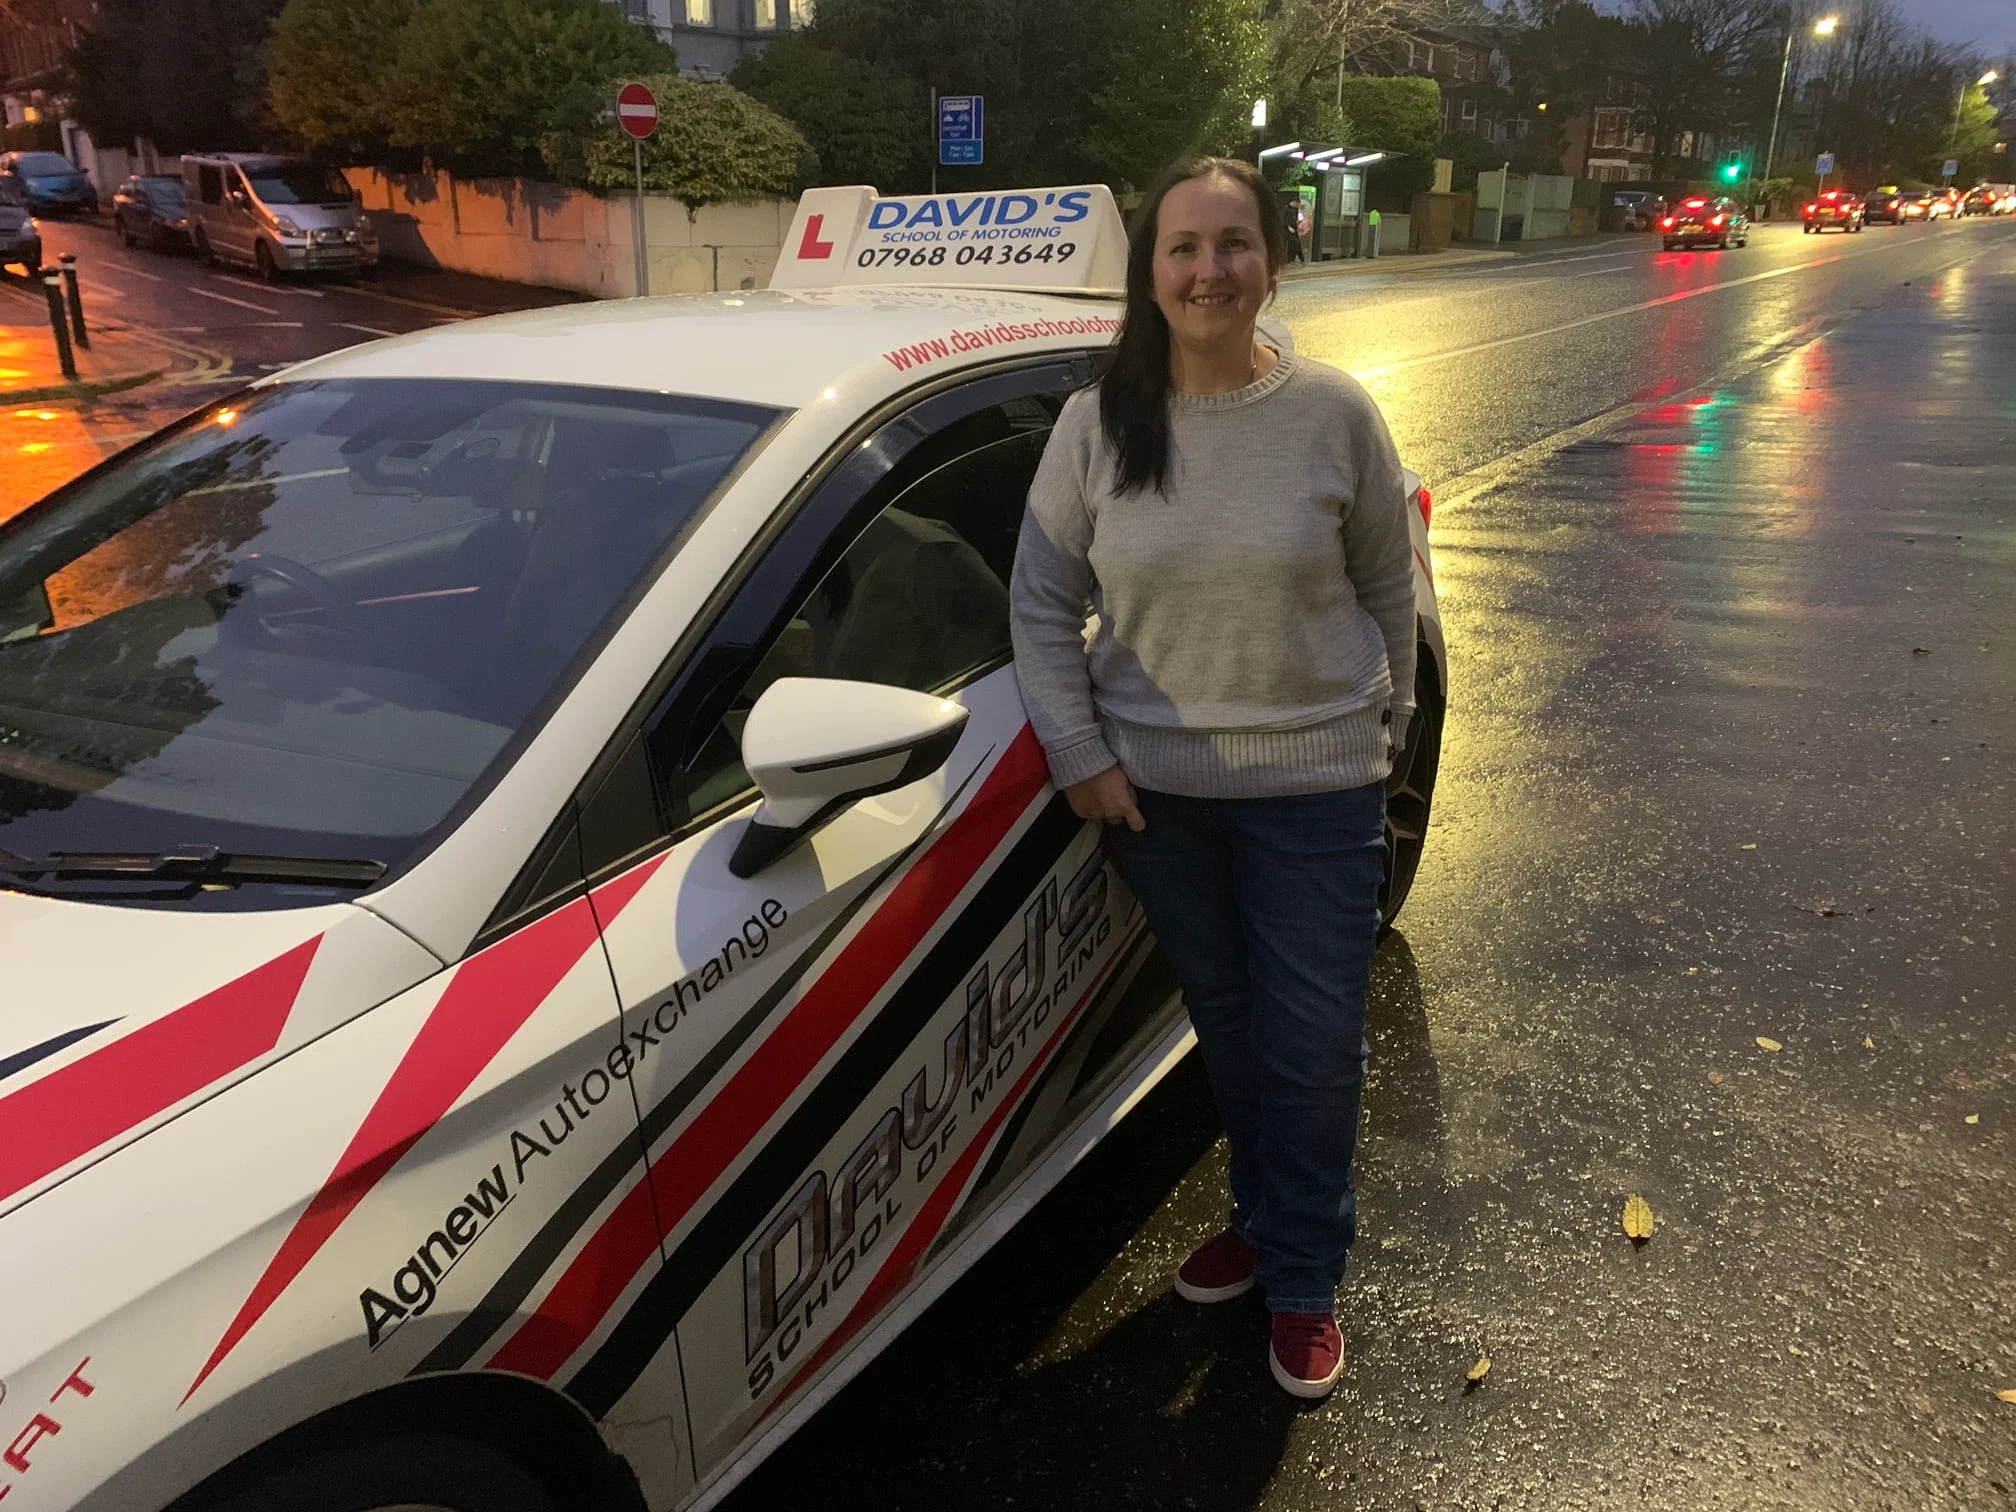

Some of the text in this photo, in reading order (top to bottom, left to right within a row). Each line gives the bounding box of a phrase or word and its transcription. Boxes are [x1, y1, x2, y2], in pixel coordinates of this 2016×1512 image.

[868, 191, 1092, 230] DAVID'S
[797, 213, 834, 260] L
[857, 243, 1077, 268] 07968 043649
[881, 226, 1062, 243] SCHOOL OF MOTORING
[358, 897, 788, 1348] Agnew Autoexchange
[748, 914, 1111, 1400] SCHOOL OF MOTORING
[0, 1355, 95, 1501] AT
